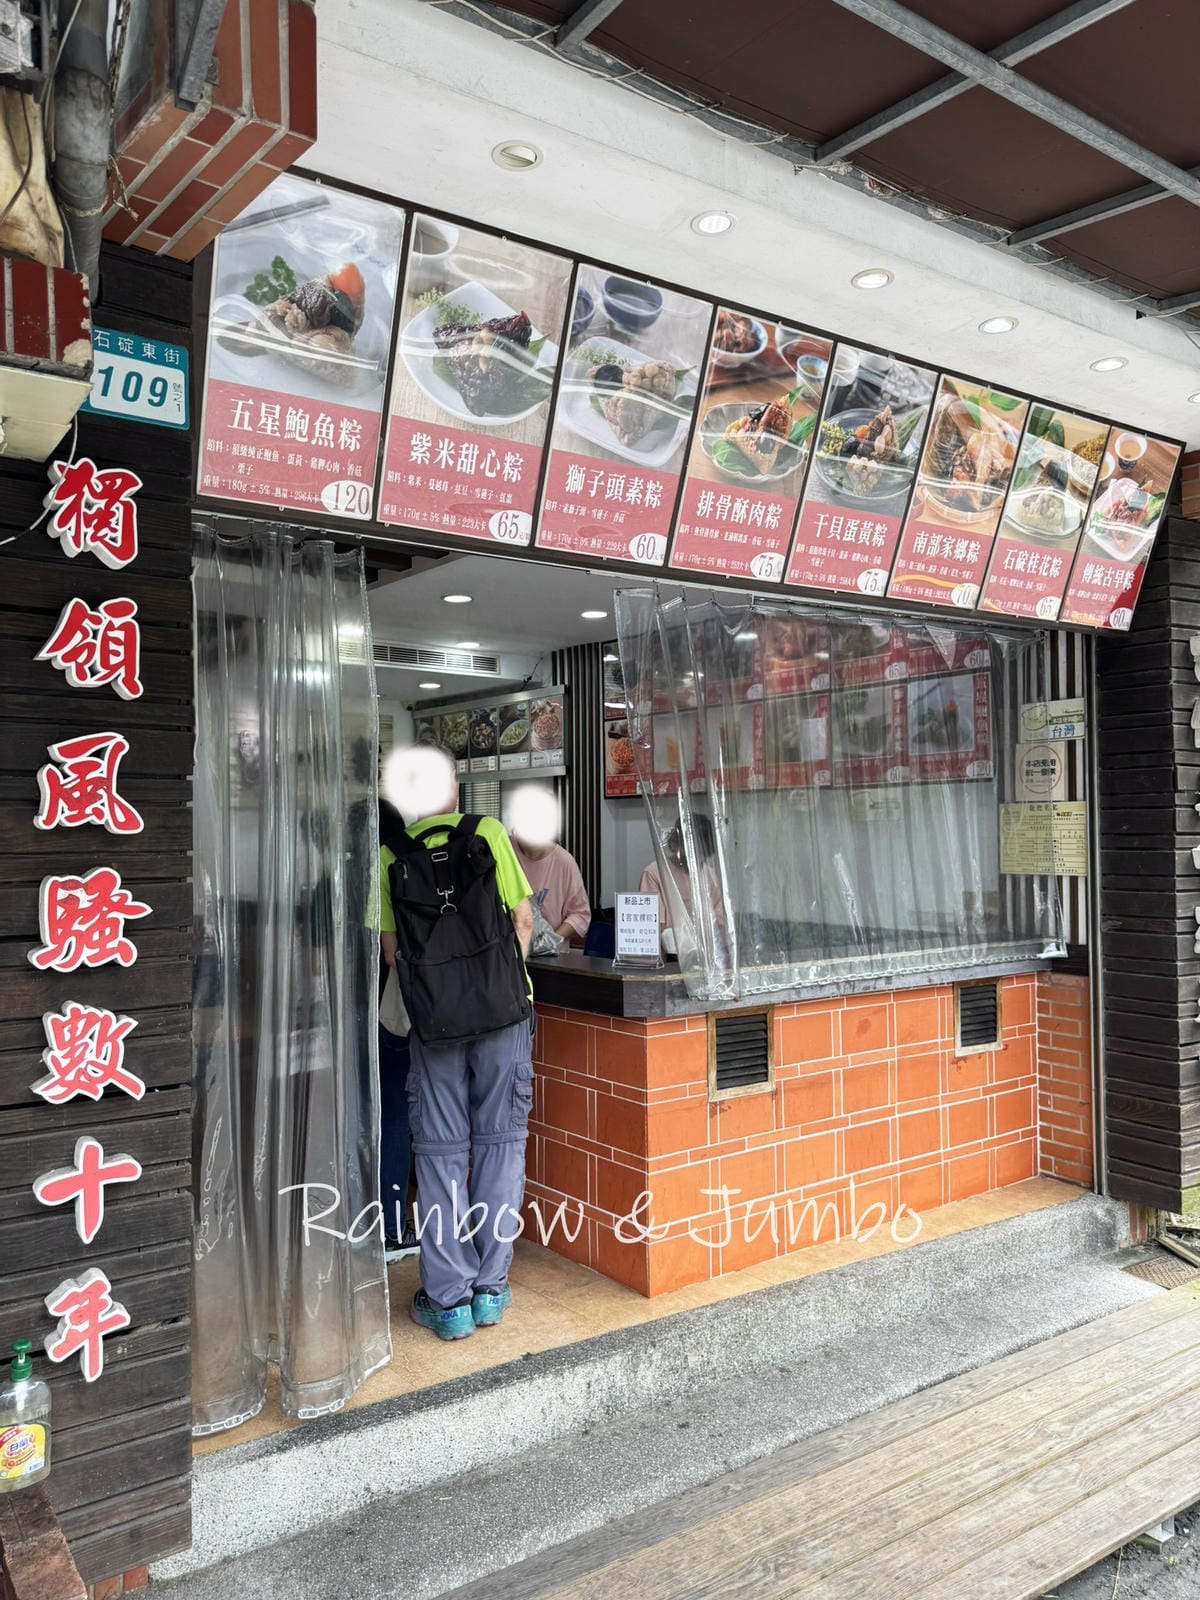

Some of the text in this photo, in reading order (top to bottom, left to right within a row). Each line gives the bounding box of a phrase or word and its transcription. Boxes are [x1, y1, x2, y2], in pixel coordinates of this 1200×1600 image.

[94, 329, 180, 365] 石碇東街
[98, 365, 169, 408] 109
[227, 398, 362, 452] 五星鮑魚粽
[408, 432, 525, 483] 紫米甜心粽
[333, 482, 370, 516] 120
[565, 464, 664, 509] 獅子頭素粽
[498, 511, 520, 539] 65
[696, 489, 783, 530] 排骨酥肉粽
[636, 534, 656, 560] 60
[813, 513, 888, 548] 干貝蛋黃粽
[912, 530, 981, 564] 南部家鄉粽
[760, 554, 774, 578] 75
[1002, 548, 1063, 578] 石碇桂花粽
[1081, 562, 1135, 592] 傳統古早粽
[865, 571, 879, 592] 75
[1113, 610, 1125, 627] 60
[1051, 724, 1076, 738] 台灣
[624, 896, 651, 906] 新品上市
[27, 457, 153, 1383] 獨領風騷數十年
